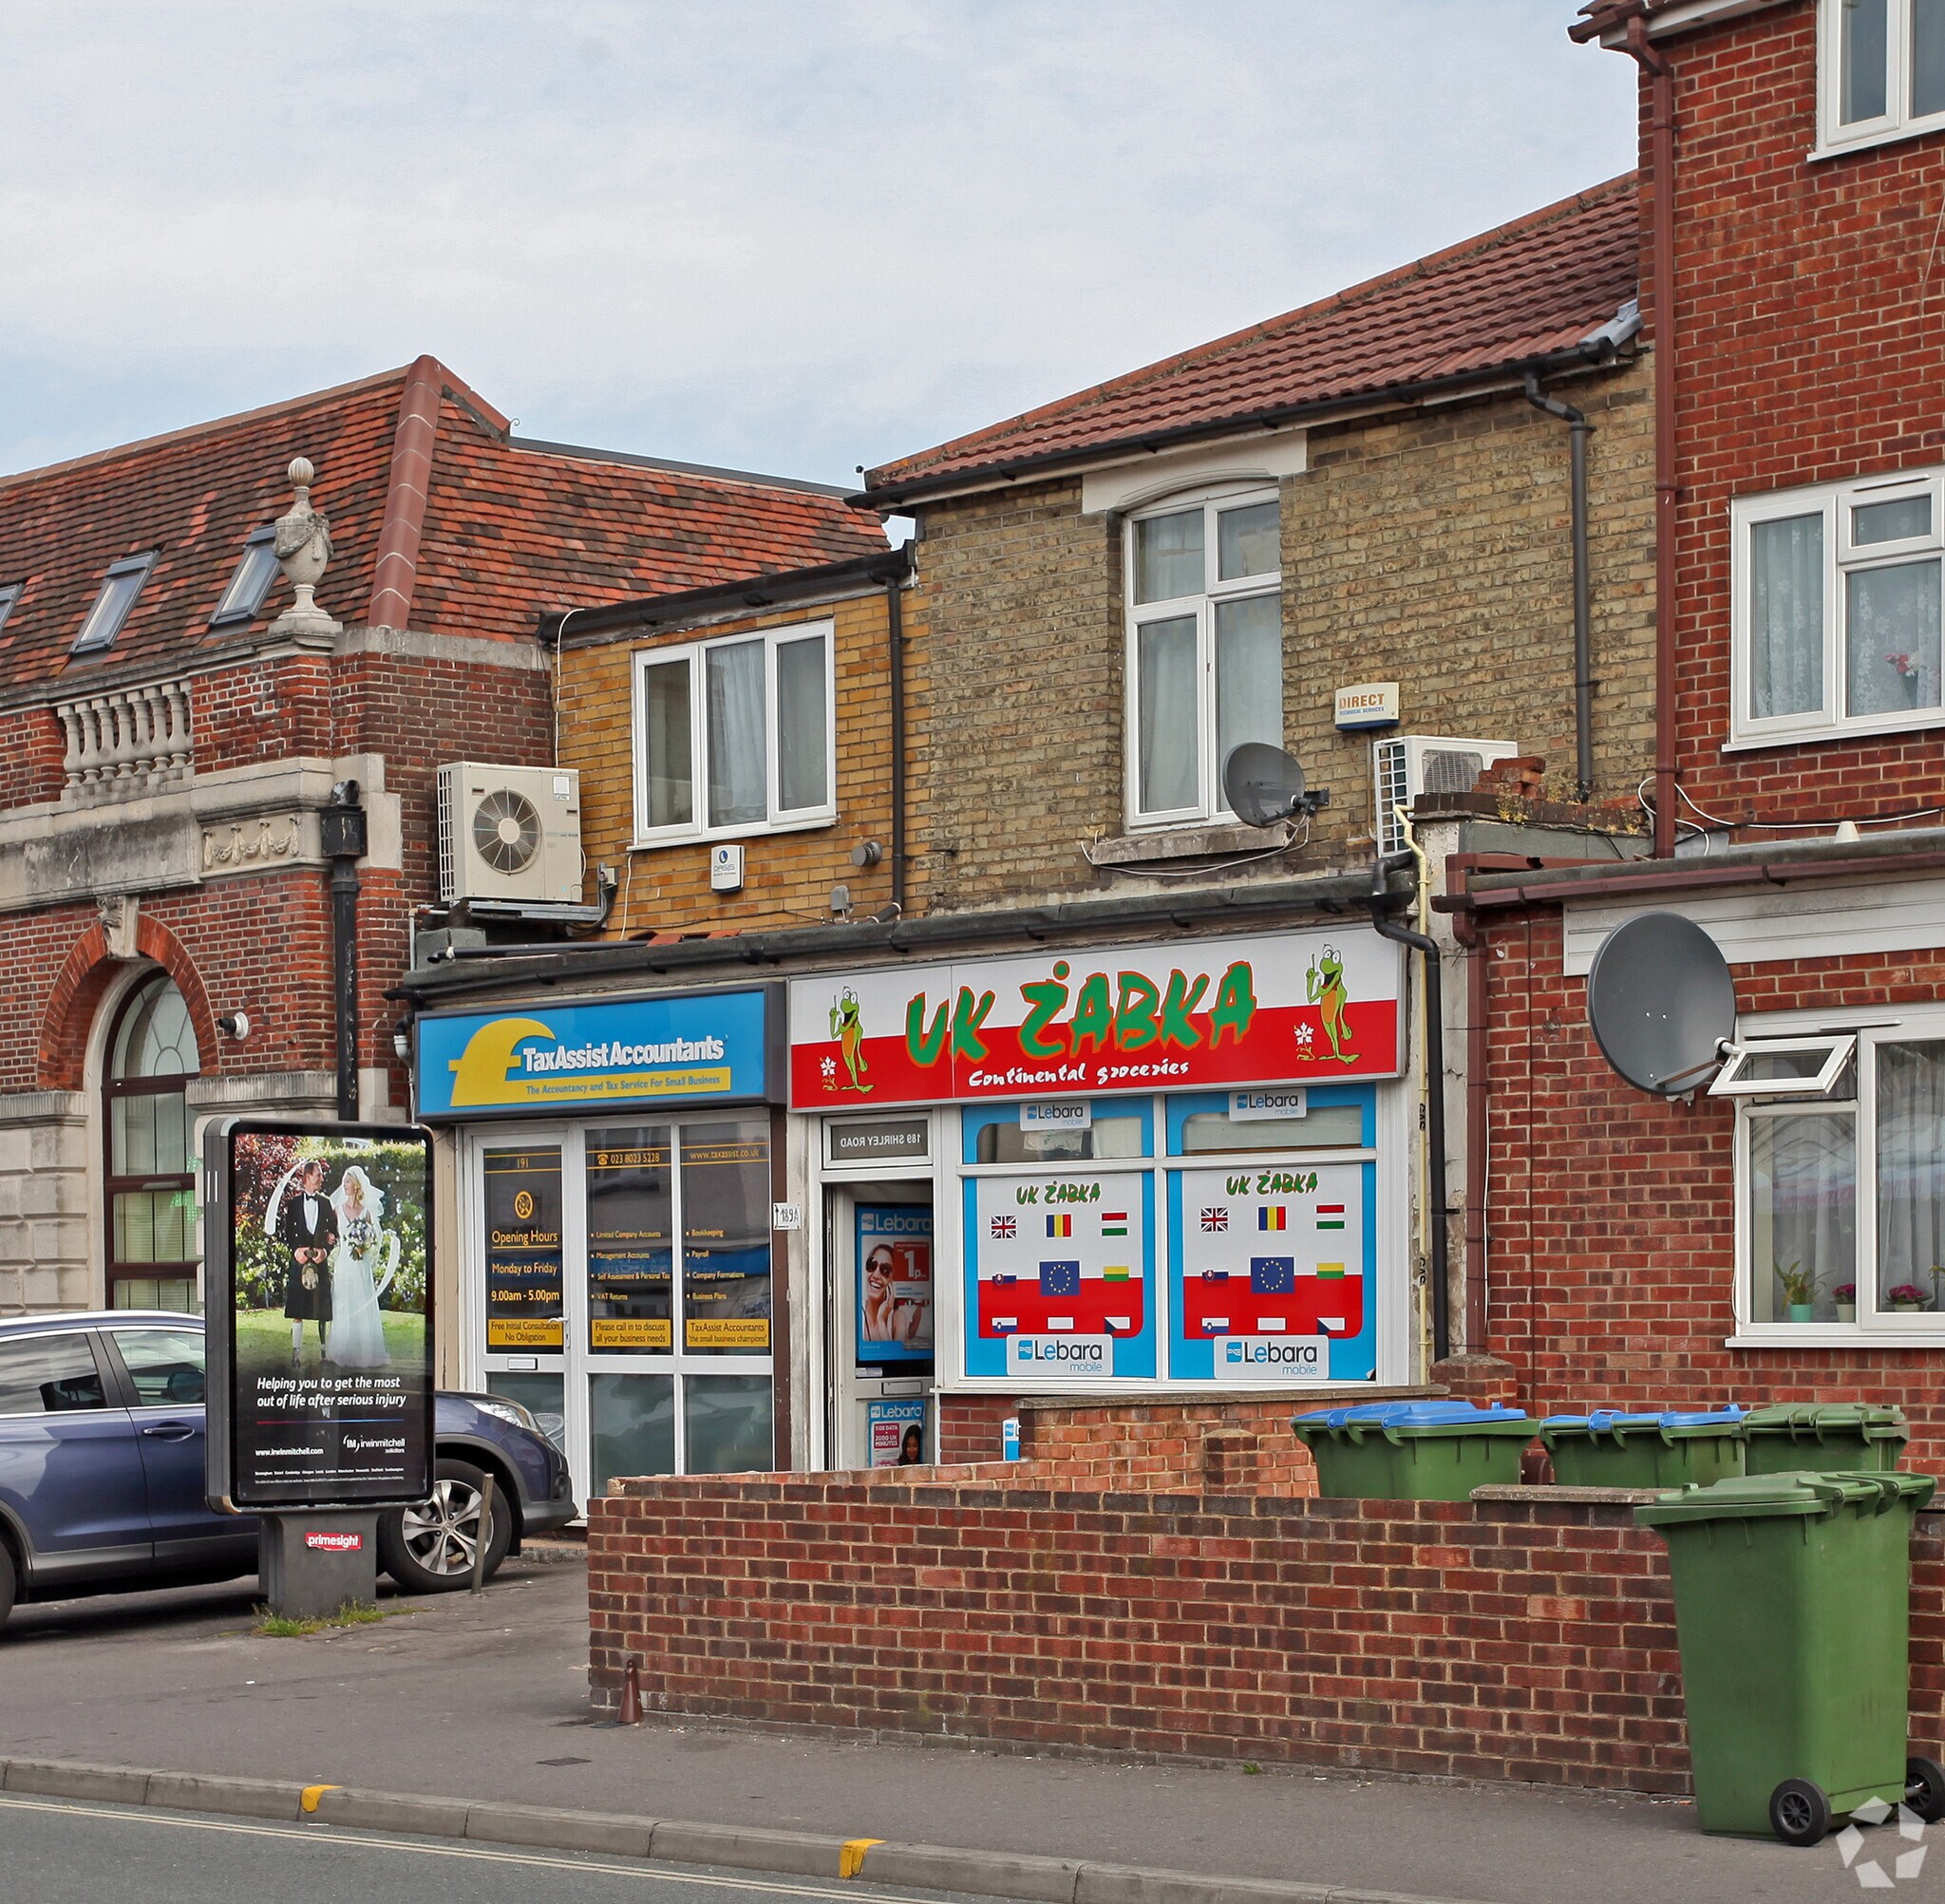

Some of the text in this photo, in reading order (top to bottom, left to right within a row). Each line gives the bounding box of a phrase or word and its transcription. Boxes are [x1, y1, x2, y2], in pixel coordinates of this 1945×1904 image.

[1338, 693, 1385, 709] DIRECT
[905, 959, 1258, 1068] UK ŻABKA
[523, 1035, 725, 1072] TaxAssist Accountants
[968, 1057, 1190, 1088] Continental groceries
[526, 1075, 721, 1095] The Accountancy and Tax Service For Small Business
[1248, 1094, 1299, 1108] Lebara
[1039, 1104, 1085, 1121] Lebara
[1274, 1106, 1299, 1116] mobile
[1061, 1117, 1085, 1126] mobile
[610, 1152, 660, 1164] 023 8023 5228
[689, 1147, 760, 1159] www.taxassist.co.uk
[517, 1158, 529, 1169] 191
[1225, 1169, 1319, 1197] UK ŻABKA
[1015, 1179, 1102, 1205] UK ŻABKA
[780, 1207, 799, 1223] 189A
[875, 1213, 933, 1232] Lebara
[491, 1229, 558, 1246] Opening Hours
[614, 1230, 638, 1239] Company
[691, 1229, 725, 1237] Bookkeeping
[691, 1250, 709, 1259] Payroll
[491, 1261, 558, 1276] Monday to Friday
[691, 1271, 717, 1280] Company
[491, 1290, 522, 1302] 9.00am
[528, 1289, 560, 1303] 5.00pm
[692, 1291, 727, 1300] Business Plans
[491, 1322, 505, 1330] Free
[505, 1321, 522, 1330] Initial
[595, 1322, 666, 1331] Please call in to discuss
[690, 1322, 765, 1332] TaxAssist Accountants
[504, 1331, 547, 1343] No Obligation
[603, 1334, 619, 1344] your
[619, 1333, 646, 1343] business
[647, 1333, 667, 1343] needs
[713, 1334, 737, 1343] business
[1033, 1340, 1103, 1361] Lebara
[1241, 1341, 1318, 1363] Lebara
[1069, 1362, 1103, 1373] mobile
[1281, 1364, 1318, 1376] mobile
[256, 1375, 402, 1393] Helping you to get the most
[256, 1393, 407, 1409] out of life after serious injury
[880, 1404, 922, 1418] Lebara
[360, 1434, 406, 1448] irwinmitchell
[255, 1446, 324, 1456] www.irwinmitchell.com
[308, 1534, 359, 1549] primesight
